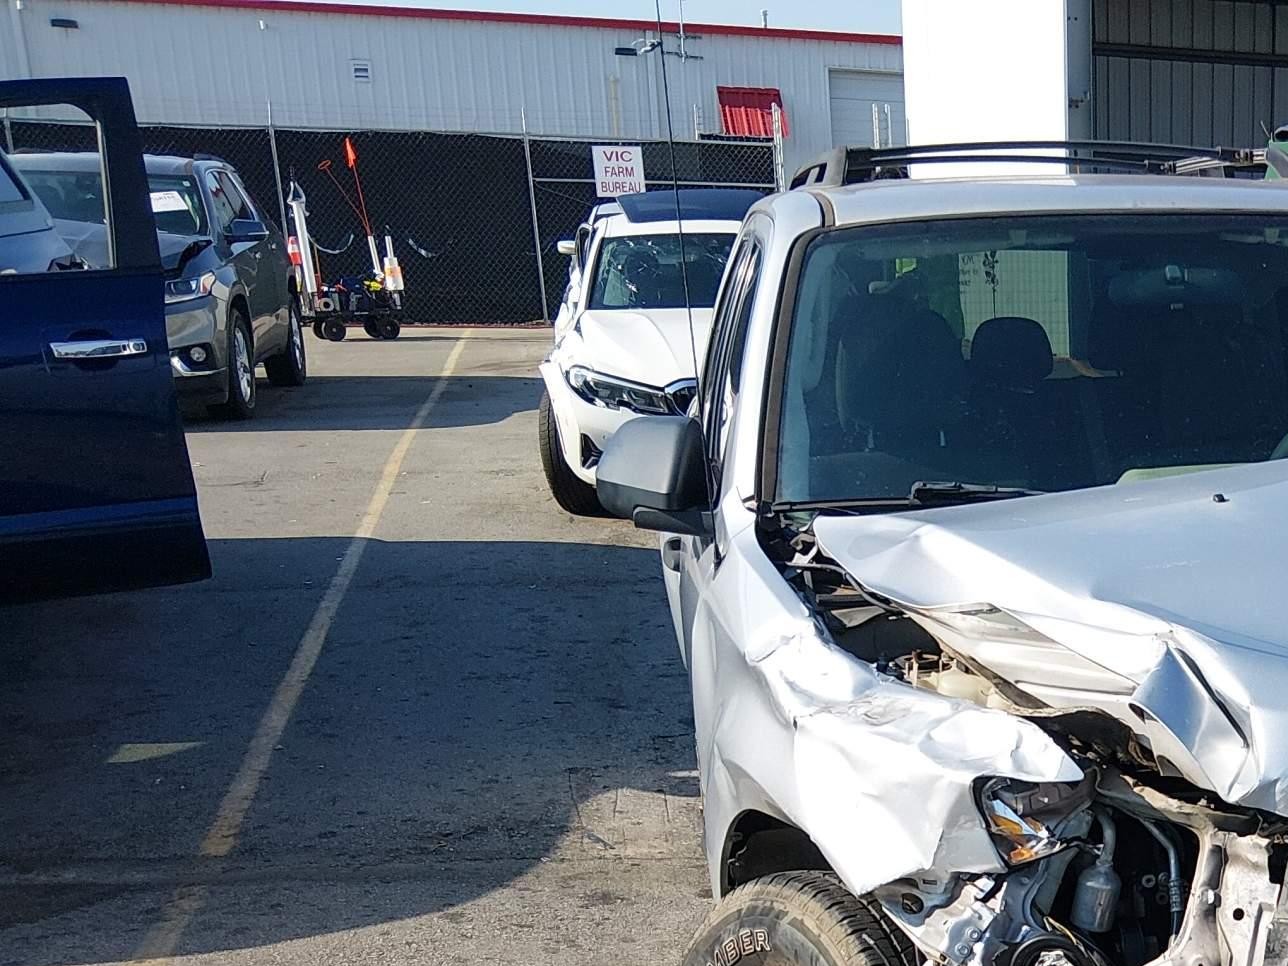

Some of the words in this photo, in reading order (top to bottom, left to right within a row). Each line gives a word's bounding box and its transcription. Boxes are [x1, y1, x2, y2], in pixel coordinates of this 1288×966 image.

[603, 151, 633, 162] VIC
[604, 166, 635, 178] FARM
[601, 181, 641, 193] BUREAU
